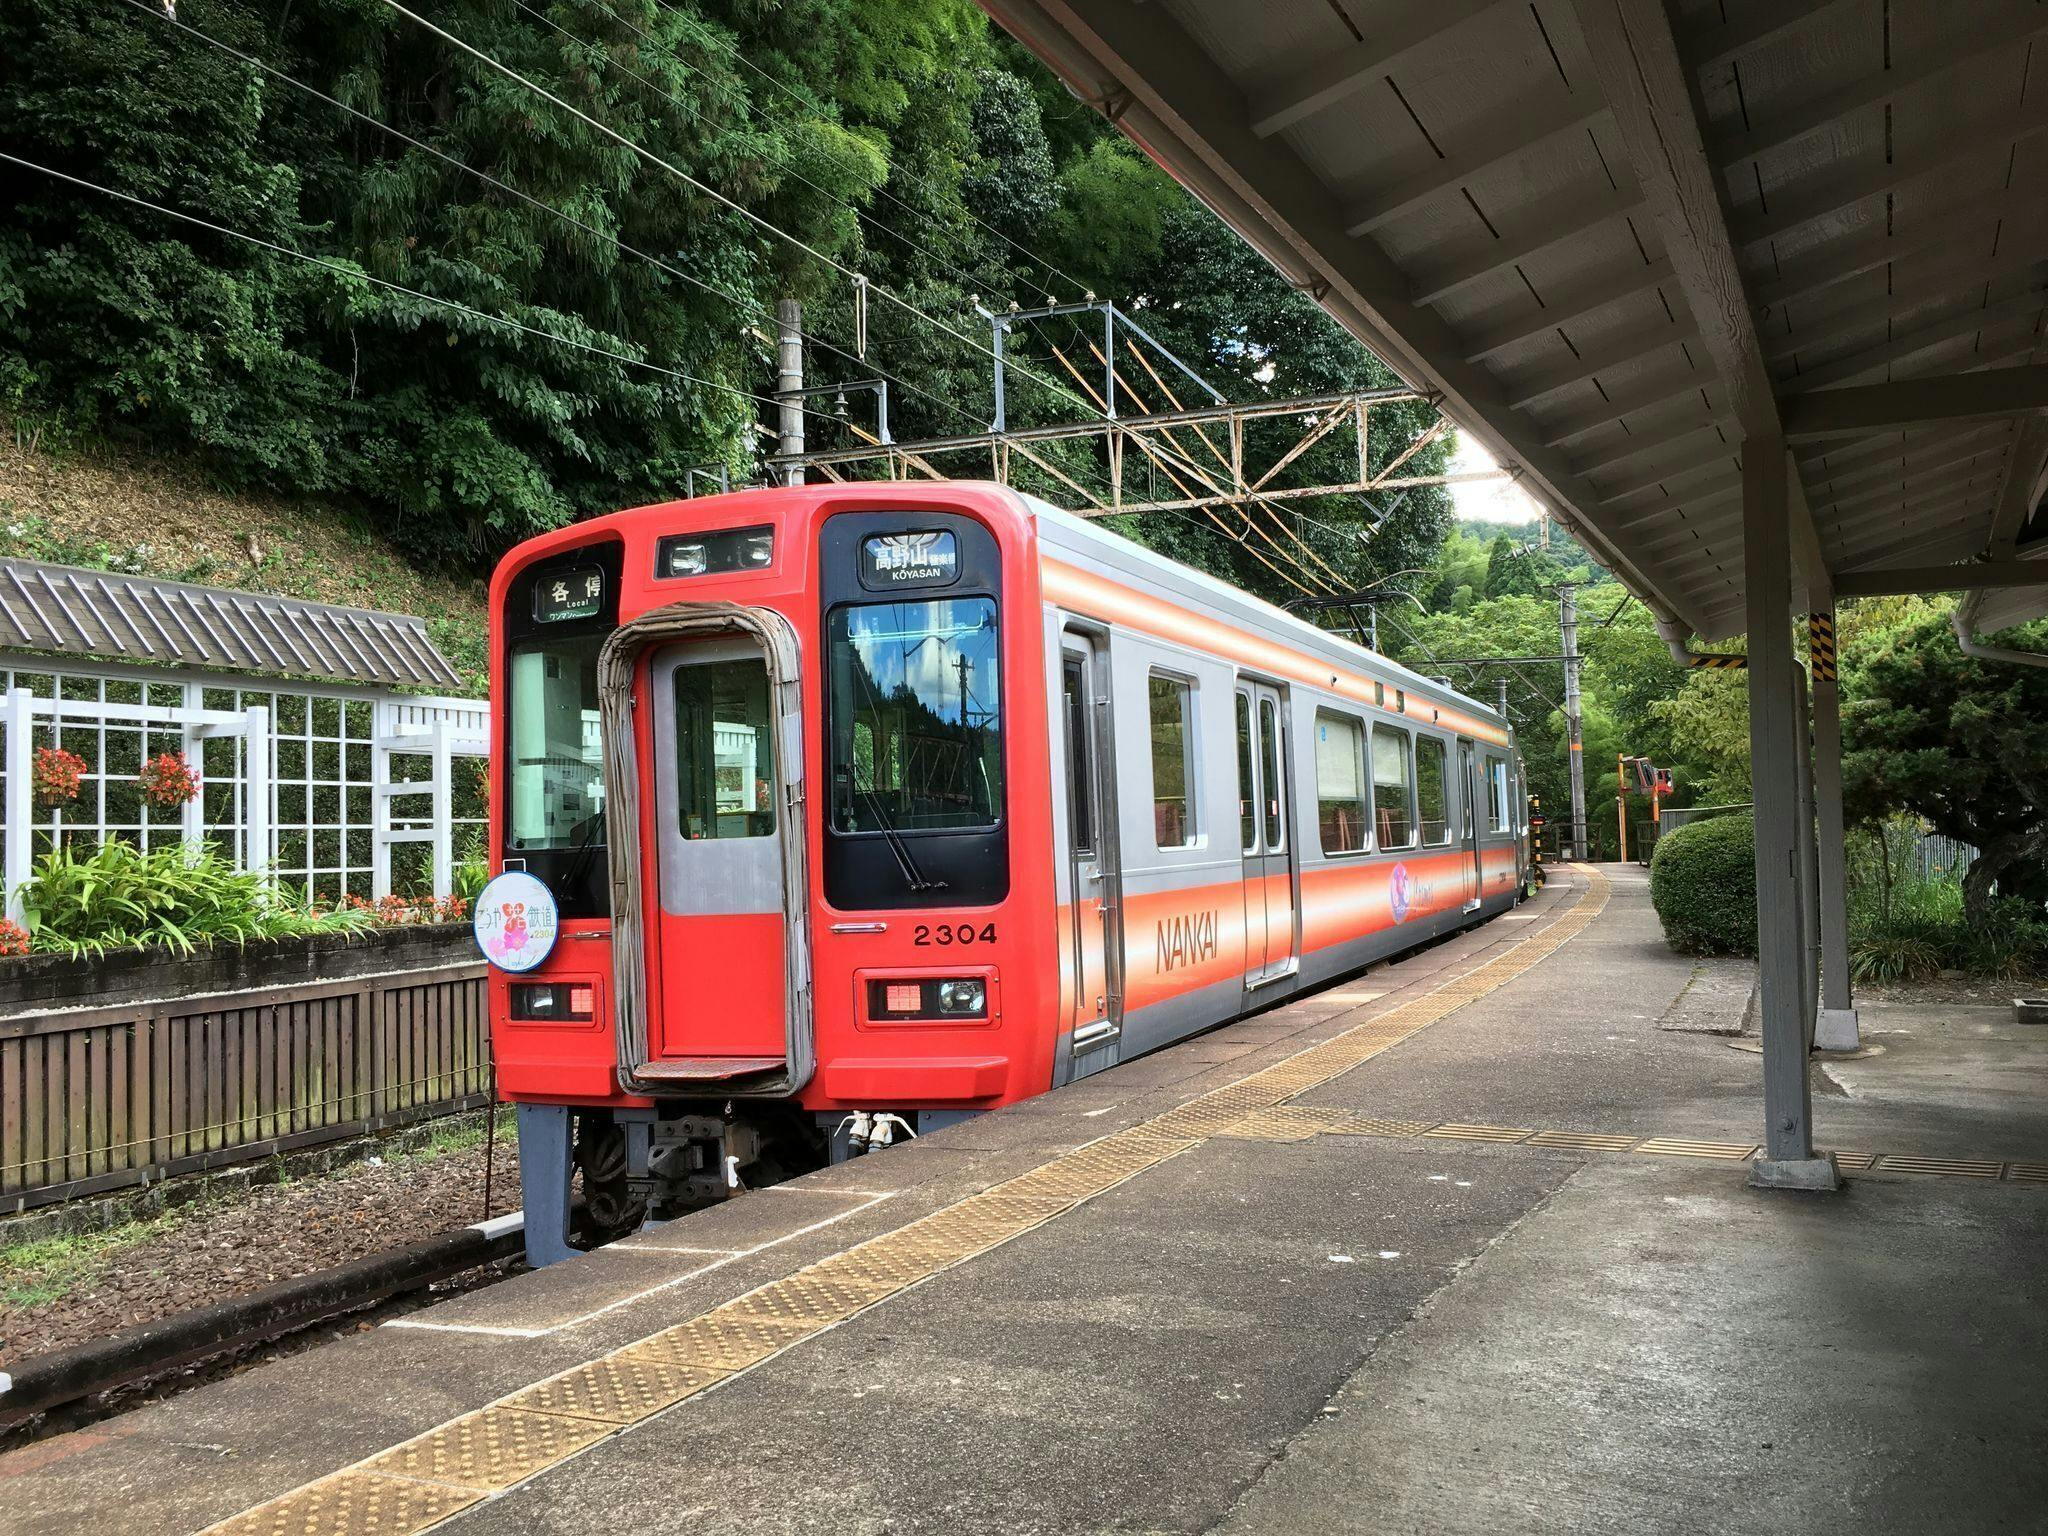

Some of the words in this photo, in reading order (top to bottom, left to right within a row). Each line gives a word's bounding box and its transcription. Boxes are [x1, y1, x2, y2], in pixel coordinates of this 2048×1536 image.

[875, 543, 928, 570] 高野山
[566, 598, 589, 608] Local
[914, 923, 997, 946] 2304
[1156, 910, 1218, 974] NANKAI
